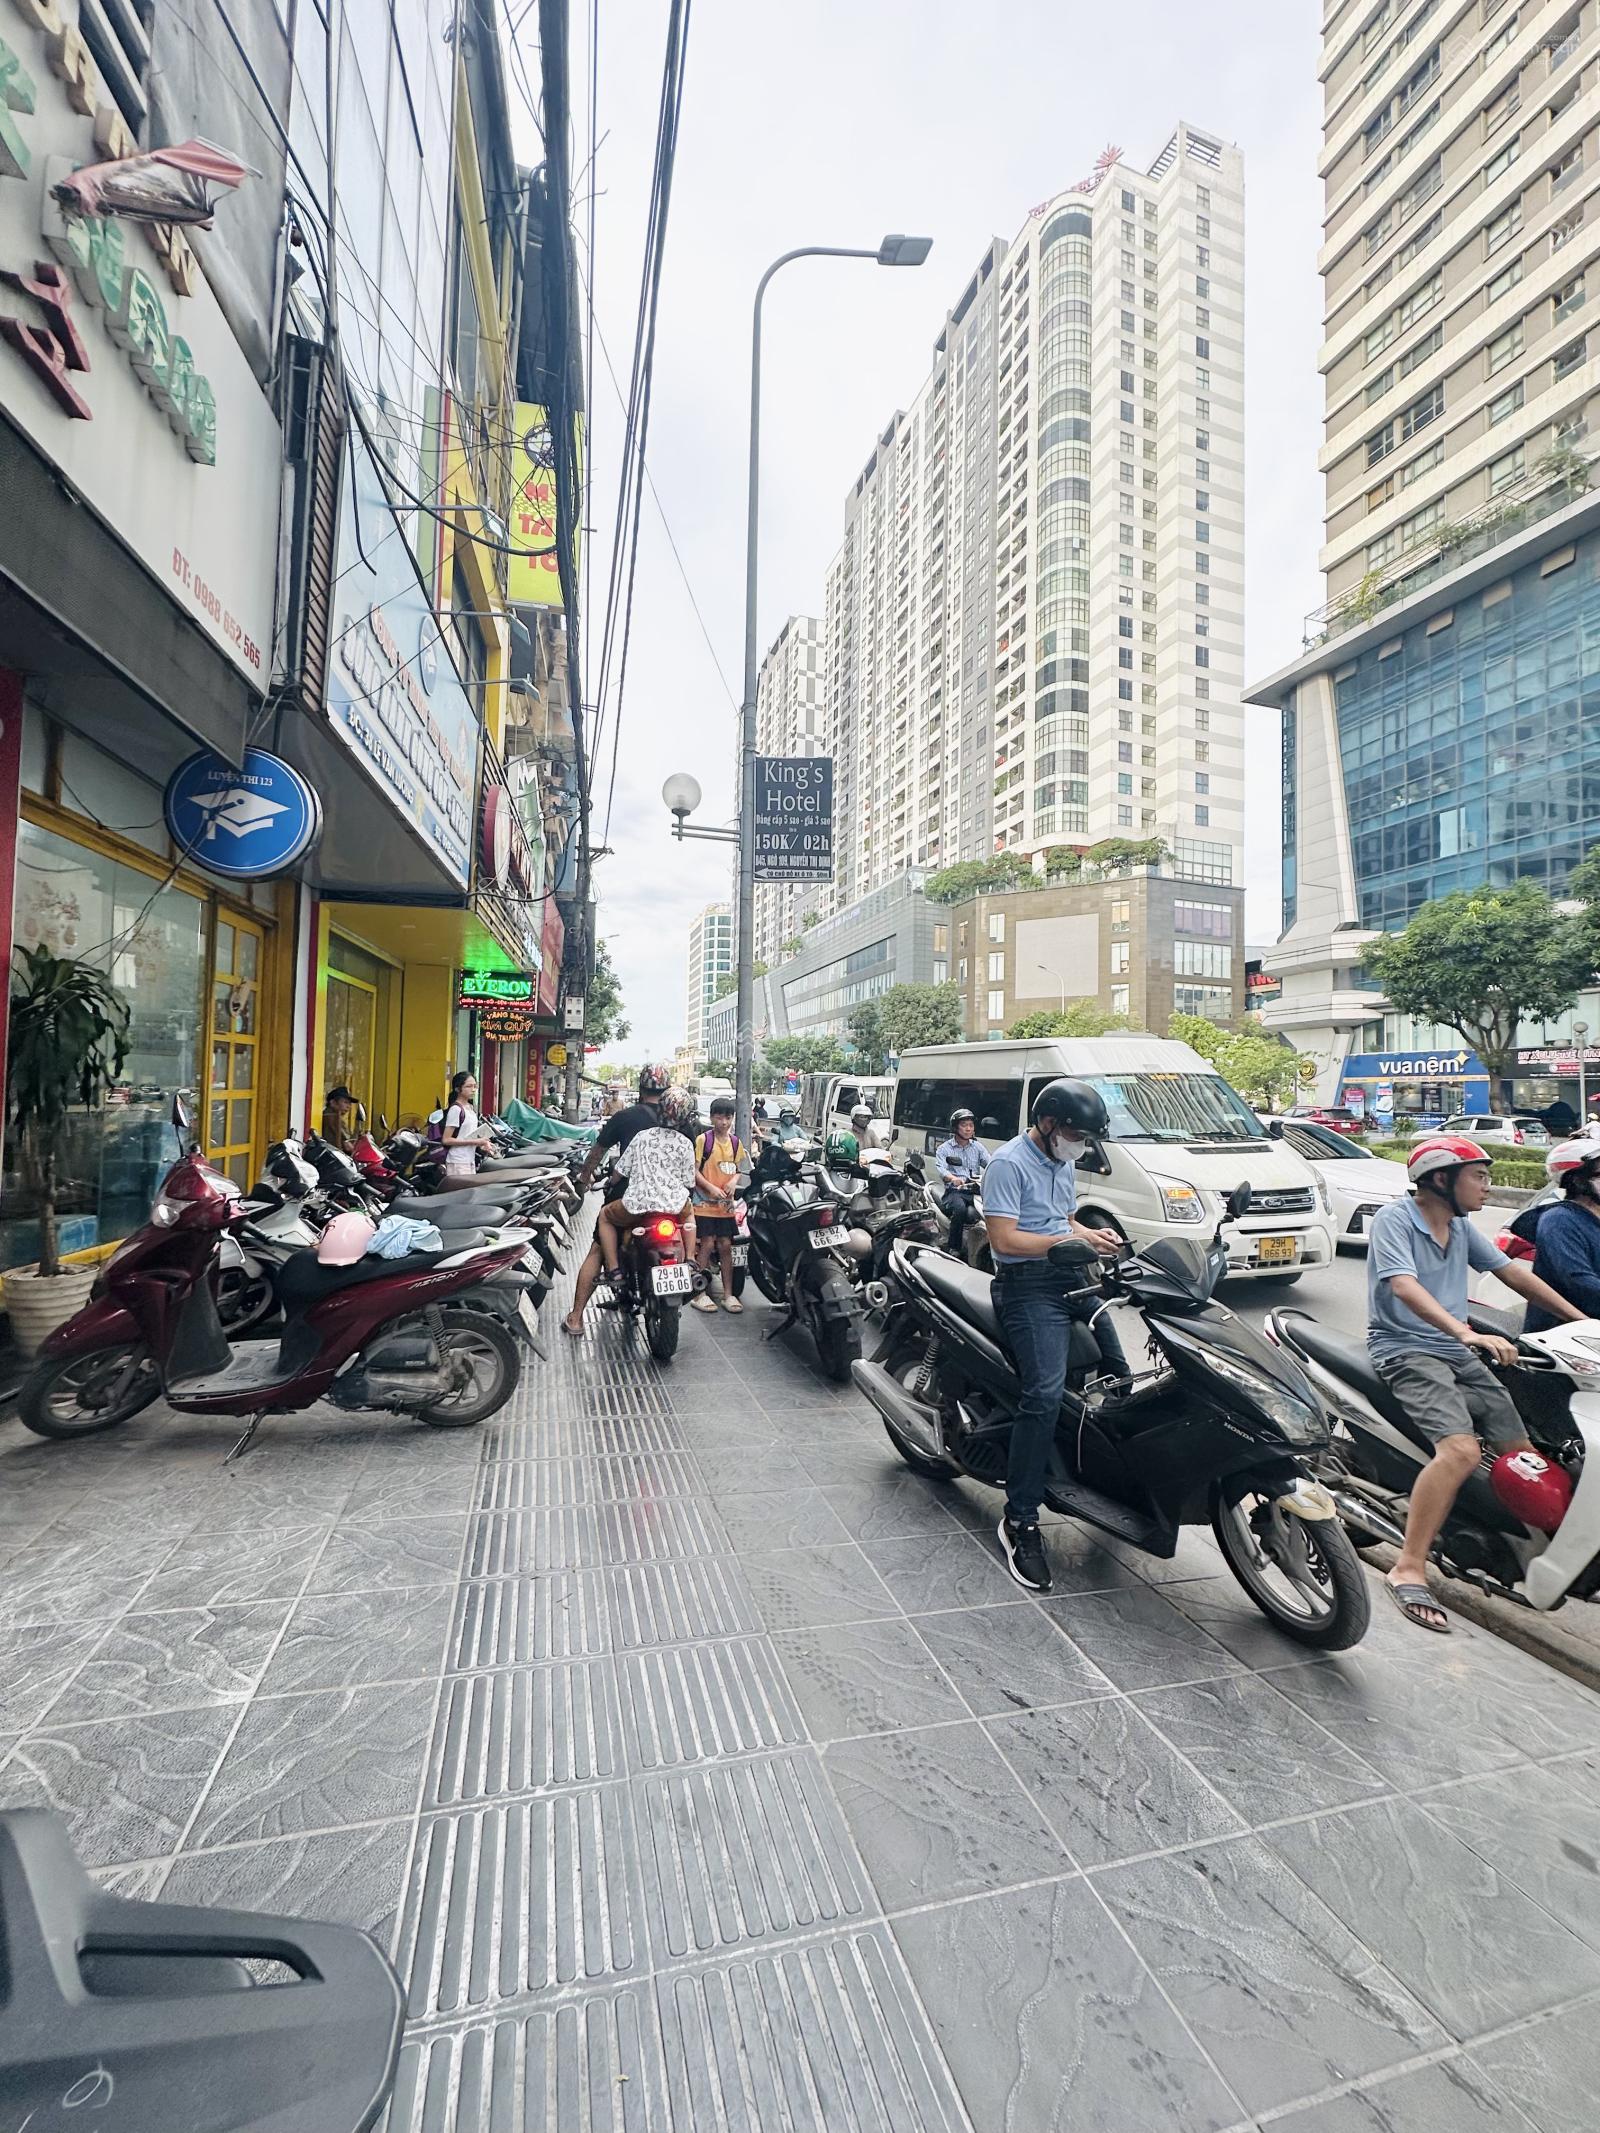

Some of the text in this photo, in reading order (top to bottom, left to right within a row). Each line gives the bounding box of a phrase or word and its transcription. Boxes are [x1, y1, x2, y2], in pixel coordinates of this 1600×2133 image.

[172, 547, 260, 670] ĐT: 0988 652 565
[241, 774, 259, 785] THI
[260, 778, 273, 786] 123
[765, 761, 824, 790] King's
[766, 790, 820, 812] Hotel
[784, 814, 788, 824] 5
[790, 816, 800, 825] sao
[804, 814, 814, 826] giá
[814, 815, 819, 825] 3
[820, 817, 831, 825] sao
[756, 834, 829, 851] 150K/ 02h
[463, 977, 533, 995] EVERON
[828, 1146, 845, 1154] Grab
[1271, 1239, 1286, 1248] 29H
[657, 1266, 685, 1280] 29-BA
[656, 1279, 690, 1293] 036.06
[1223, 1421, 1255, 1443] HONDA
